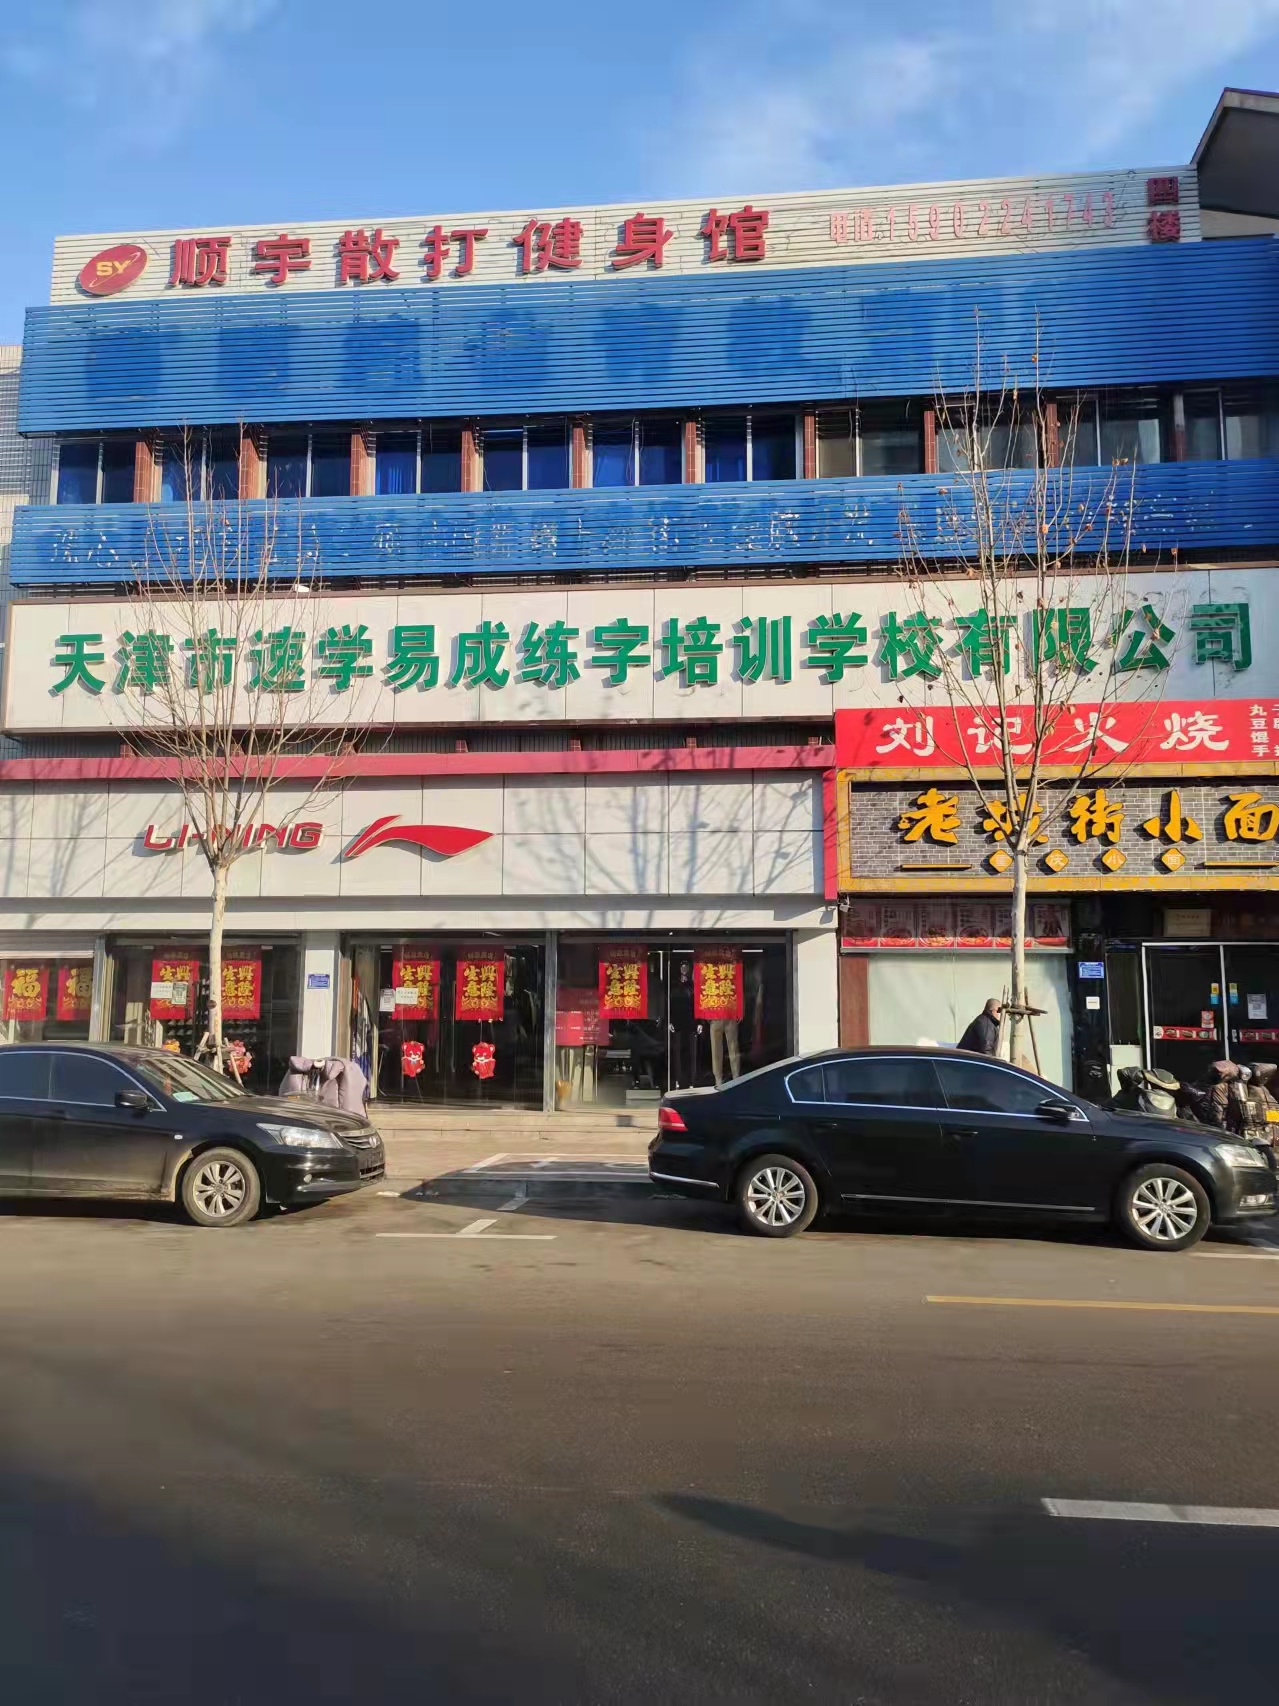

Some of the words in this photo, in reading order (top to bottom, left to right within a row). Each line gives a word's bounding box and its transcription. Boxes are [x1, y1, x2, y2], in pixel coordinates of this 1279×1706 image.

[1148, 176, 1181, 243] 四楼
[96, 260, 131, 276] SY
[168, 206, 769, 287] 顺宇散打健身馆
[52, 603, 1252, 694] 天津市速学易成练字培训学校有限公司
[876, 711, 1230, 757] 刘记火烧
